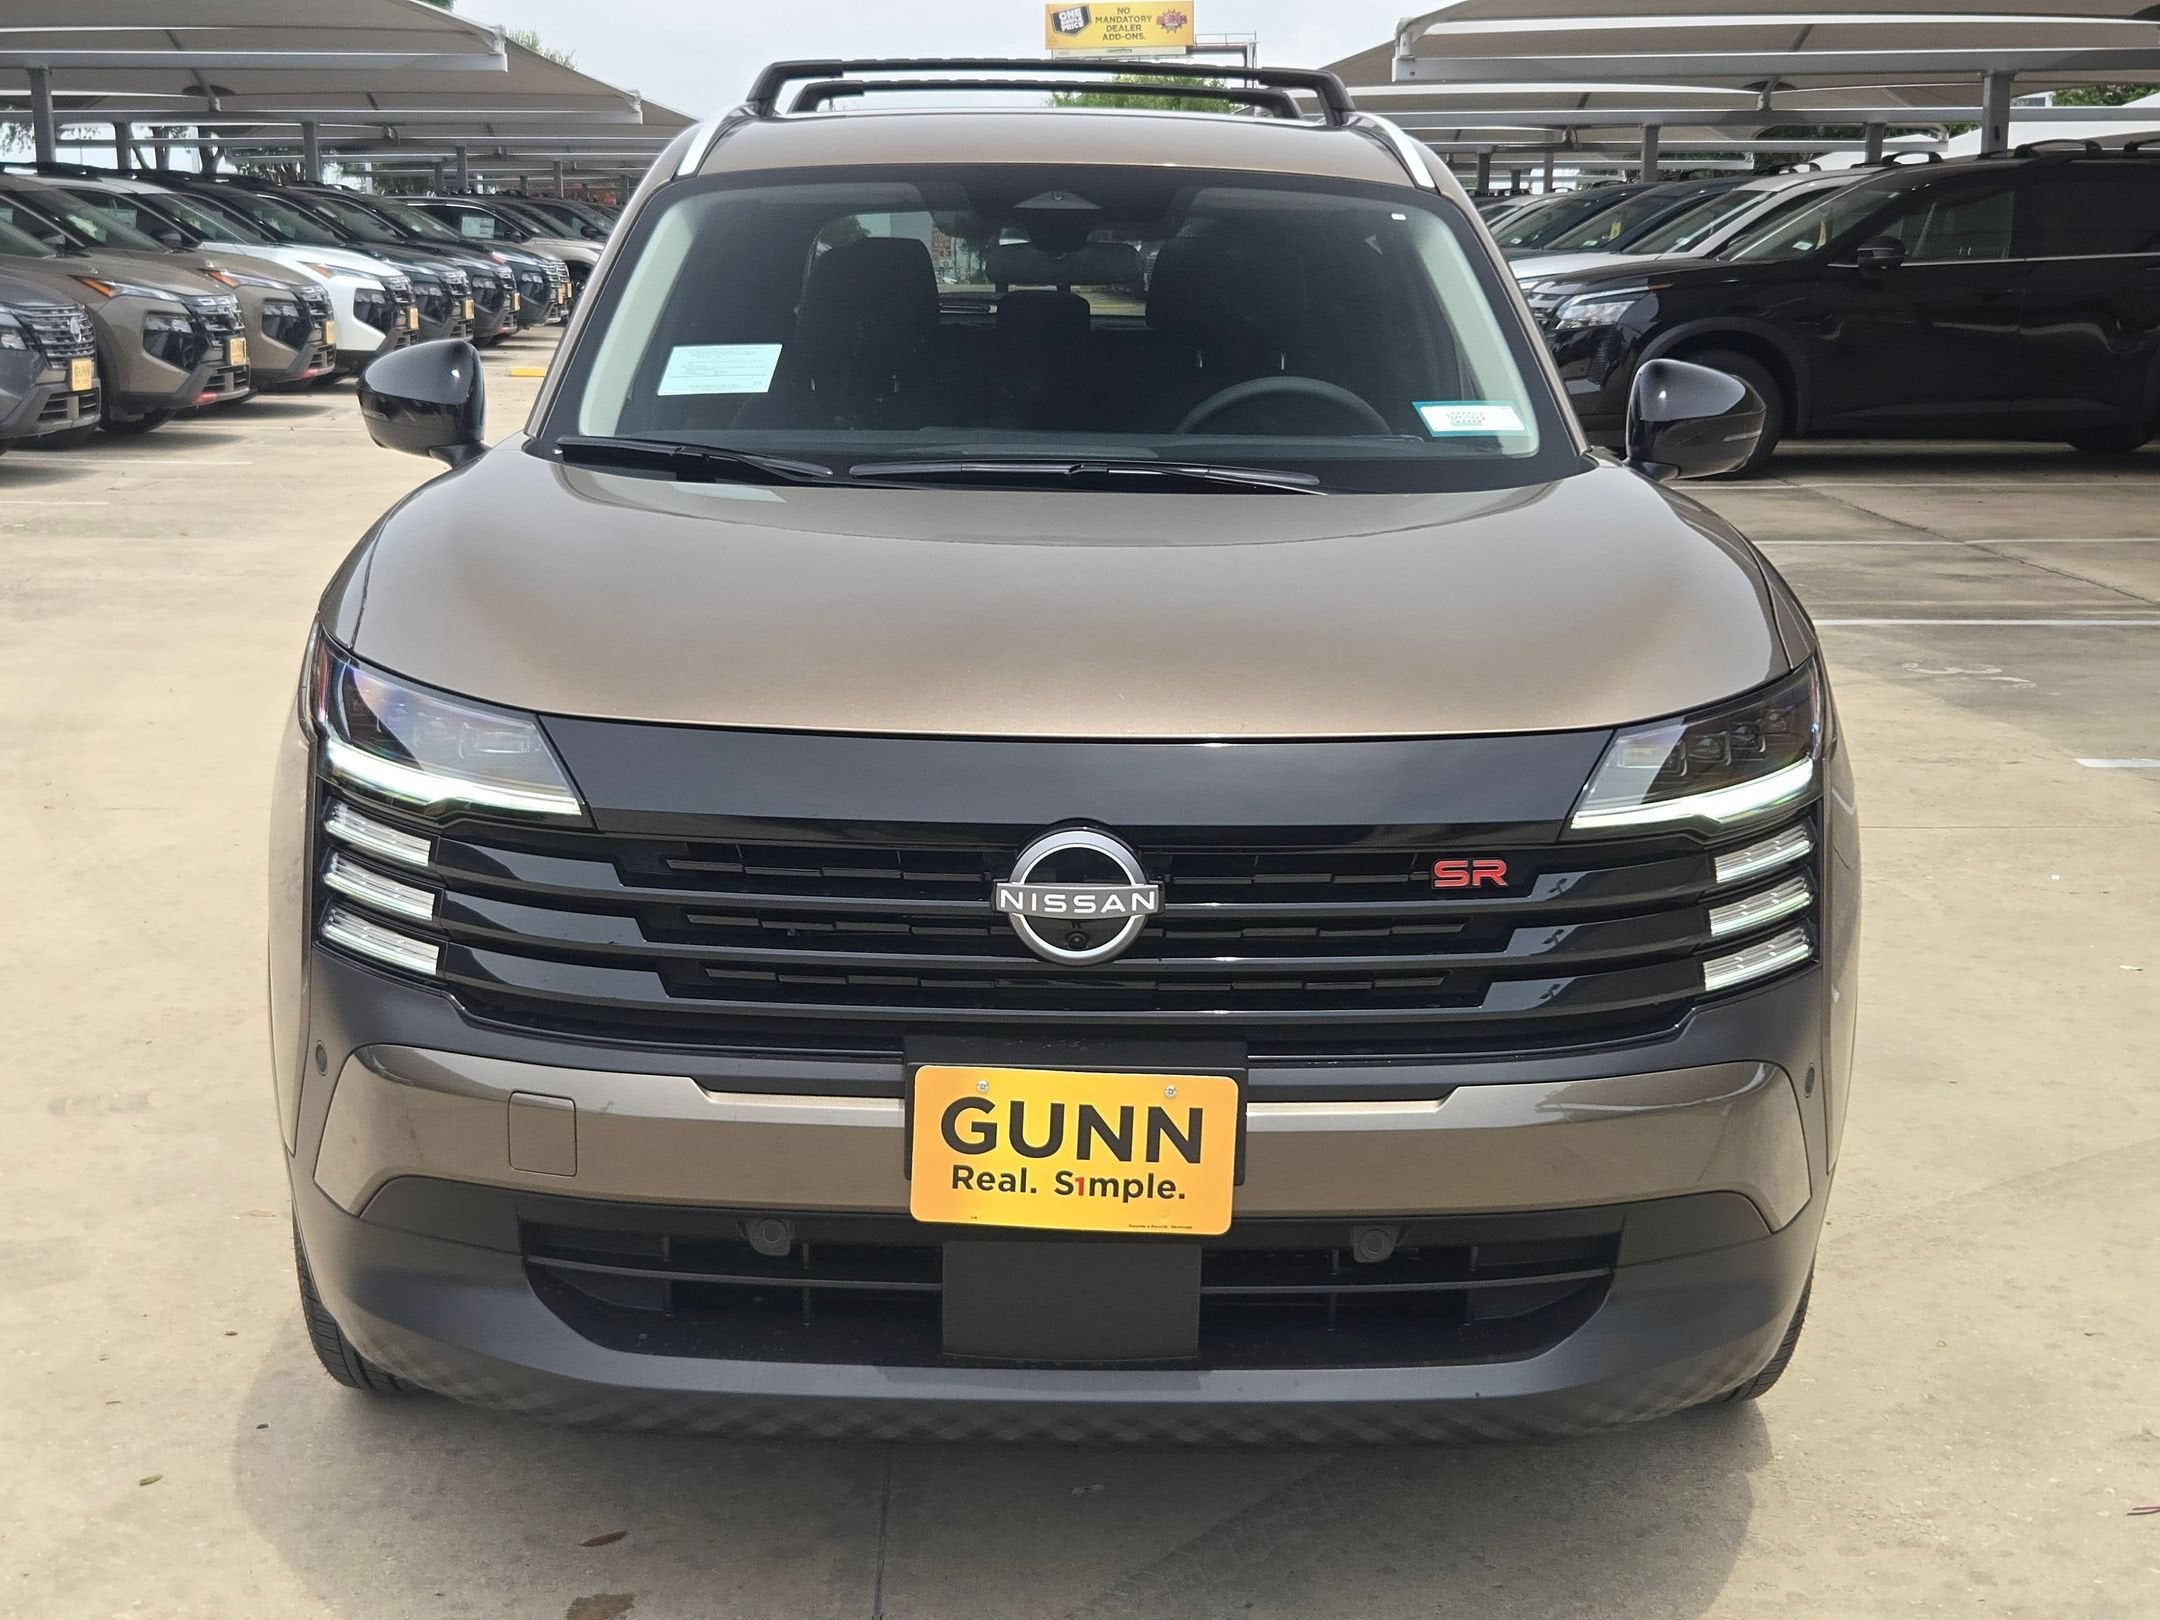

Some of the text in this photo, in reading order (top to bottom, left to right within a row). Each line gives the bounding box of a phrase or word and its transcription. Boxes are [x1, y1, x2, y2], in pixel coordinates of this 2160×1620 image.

[1059, 8, 1082, 21] ONE
[1095, 15, 1152, 24] MANDATORY
[1117, 7, 1131, 15] NO
[1106, 24, 1142, 32] DEALER
[1433, 859, 1508, 888] SR
[1000, 889, 1155, 914] NISSAN
[940, 1095, 1204, 1165] GUNN
[951, 1164, 1038, 1194] Real.
